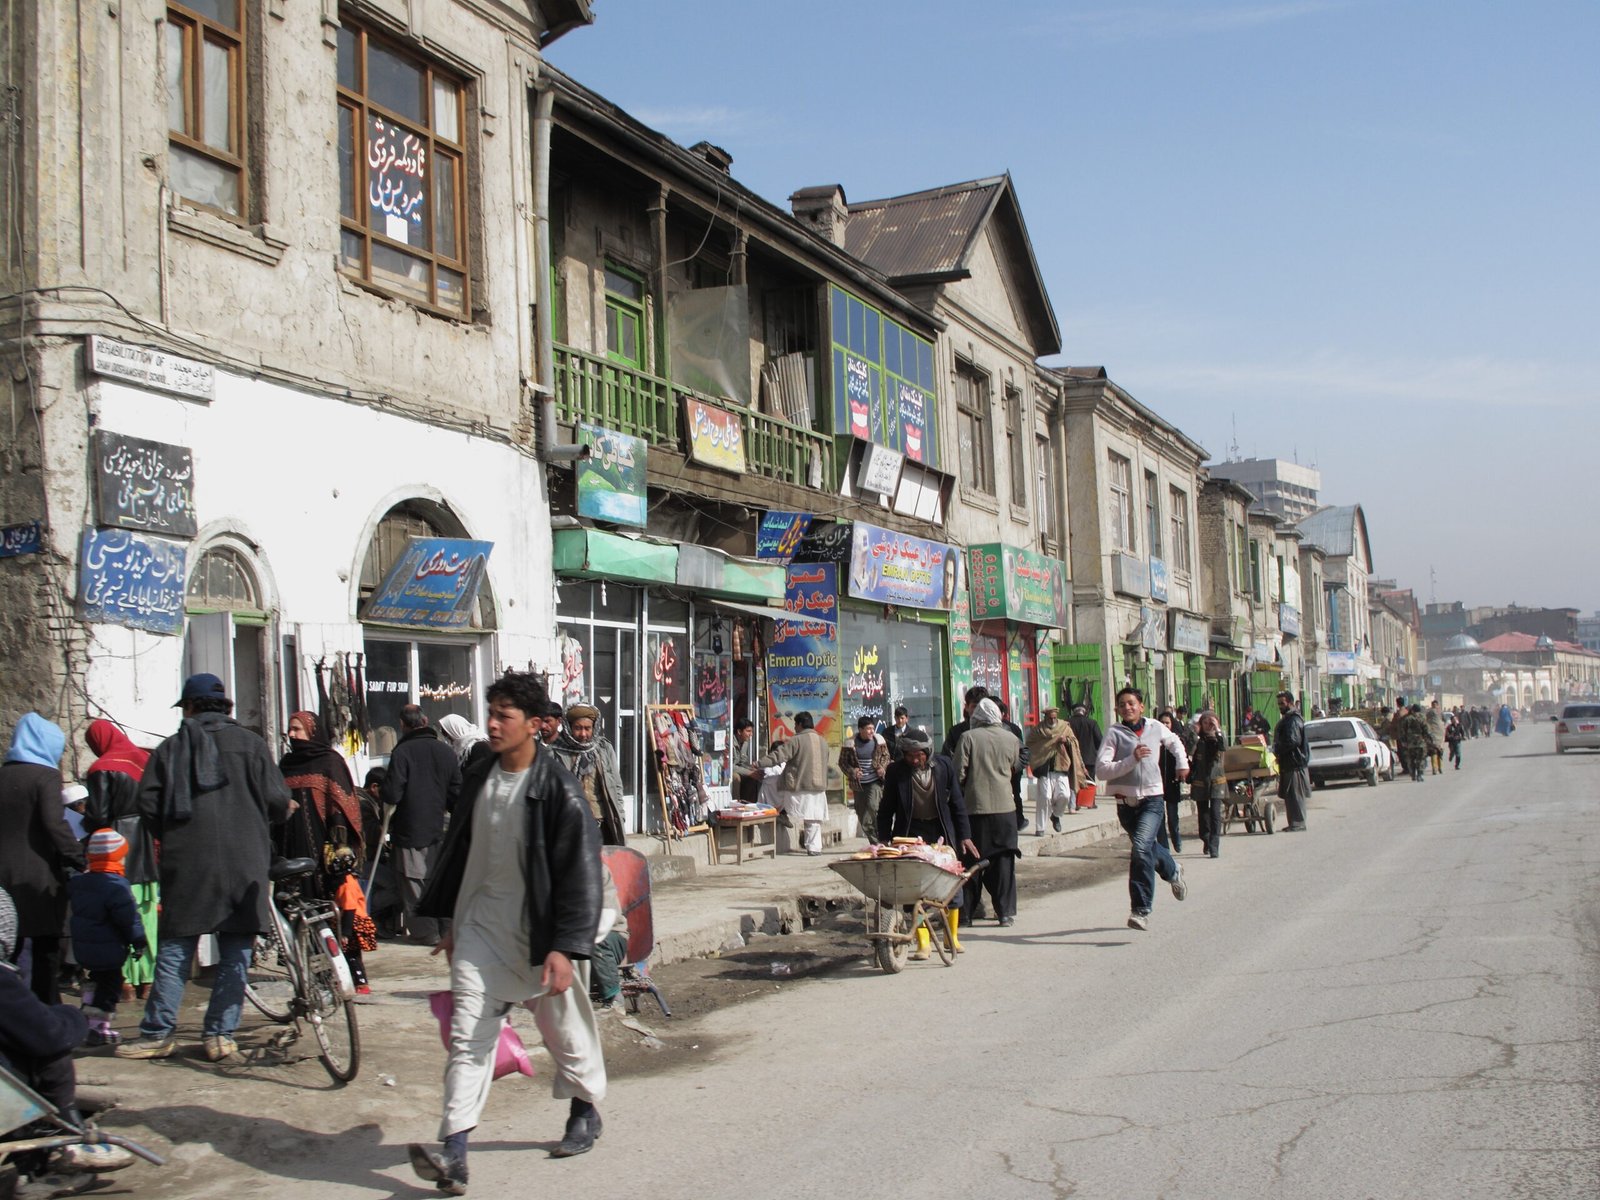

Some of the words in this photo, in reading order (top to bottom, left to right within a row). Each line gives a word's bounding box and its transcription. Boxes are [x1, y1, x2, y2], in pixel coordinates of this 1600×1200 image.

[96, 340, 153, 365] REHABILITATION
[155, 355, 165, 367] OF
[871, 533, 899, 563] فروشی
[901, 540, 919, 566] عینک
[920, 544, 942, 570] عمران
[882, 564, 909, 581] EMRAN
[910, 570, 932, 586] OPTIC
[985, 555, 1000, 607] OPTIC
[805, 590, 835, 614] عینک
[798, 621, 827, 641] عینک
[653, 641, 675, 686] خیاطی
[769, 653, 804, 668] Emran
[806, 651, 836, 670] Optic
[853, 644, 879, 675] عمران
[369, 681, 386, 692] SADAT
[386, 682, 397, 693] FUR
[397, 682, 409, 693] SKIN
